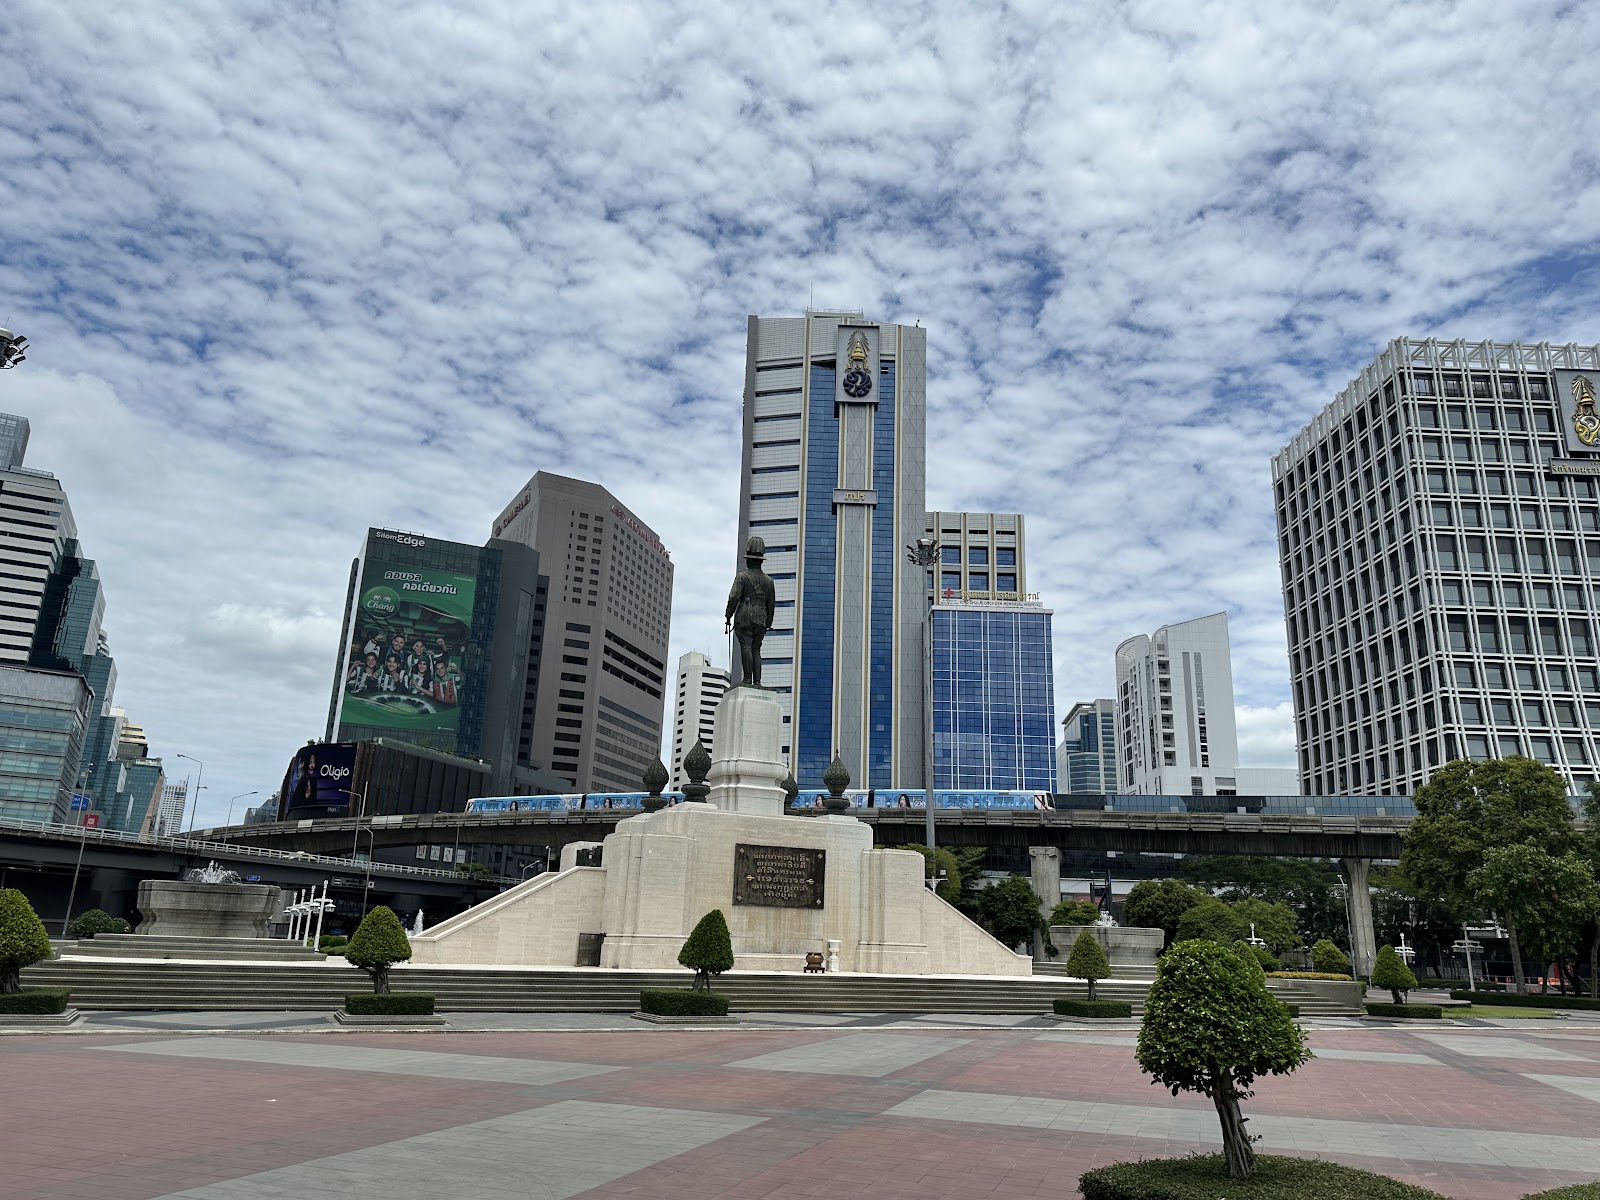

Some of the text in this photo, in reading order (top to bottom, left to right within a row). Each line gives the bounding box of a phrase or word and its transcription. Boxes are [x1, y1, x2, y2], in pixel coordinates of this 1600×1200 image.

[385, 571, 422, 582] คอบอล
[402, 582, 457, 594] คอเดียวกัน
[367, 600, 395, 612] Chang
[320, 764, 350, 780] Oligio
